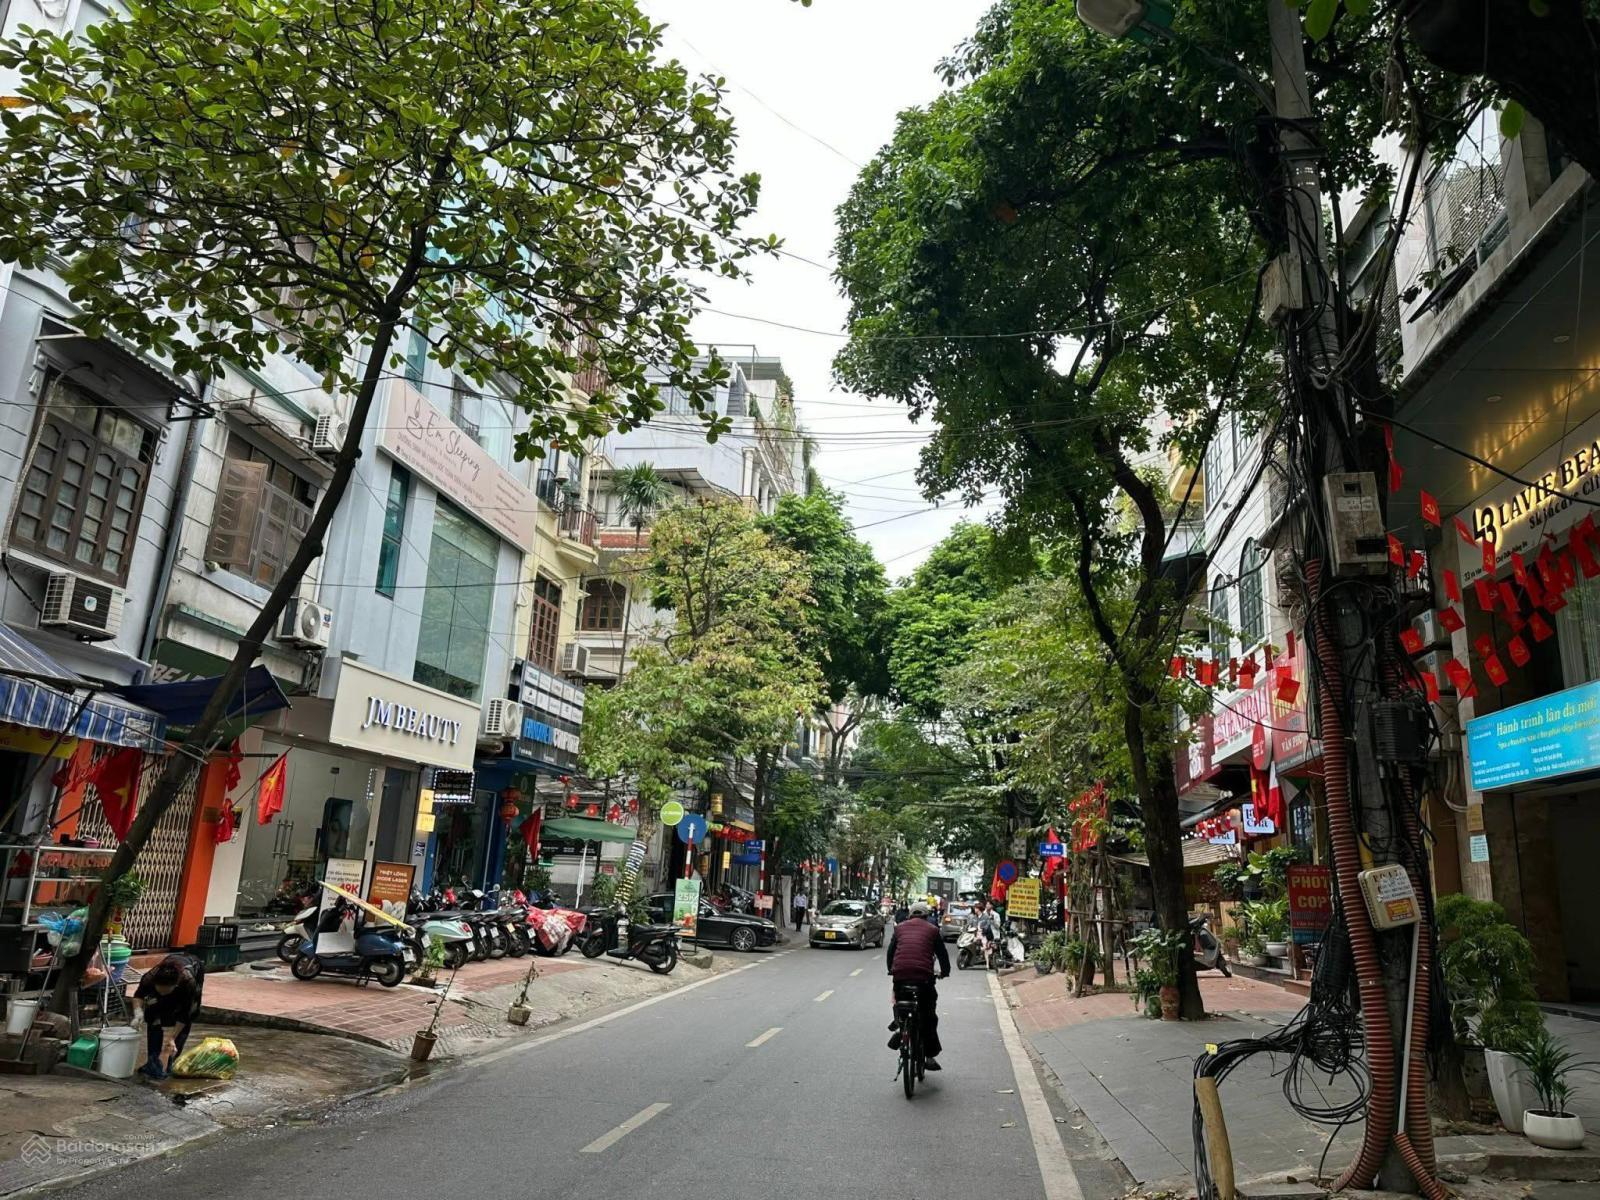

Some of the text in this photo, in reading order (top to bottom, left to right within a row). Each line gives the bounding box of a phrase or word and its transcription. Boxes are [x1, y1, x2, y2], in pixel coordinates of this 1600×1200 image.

[446, 430, 480, 481] Sleeping
[1498, 472, 1553, 525] LAVIE
[362, 697, 461, 744] JM BEAUTY
[1221, 683, 1268, 738] GENERALI
[1497, 719, 1519, 736] Hành
